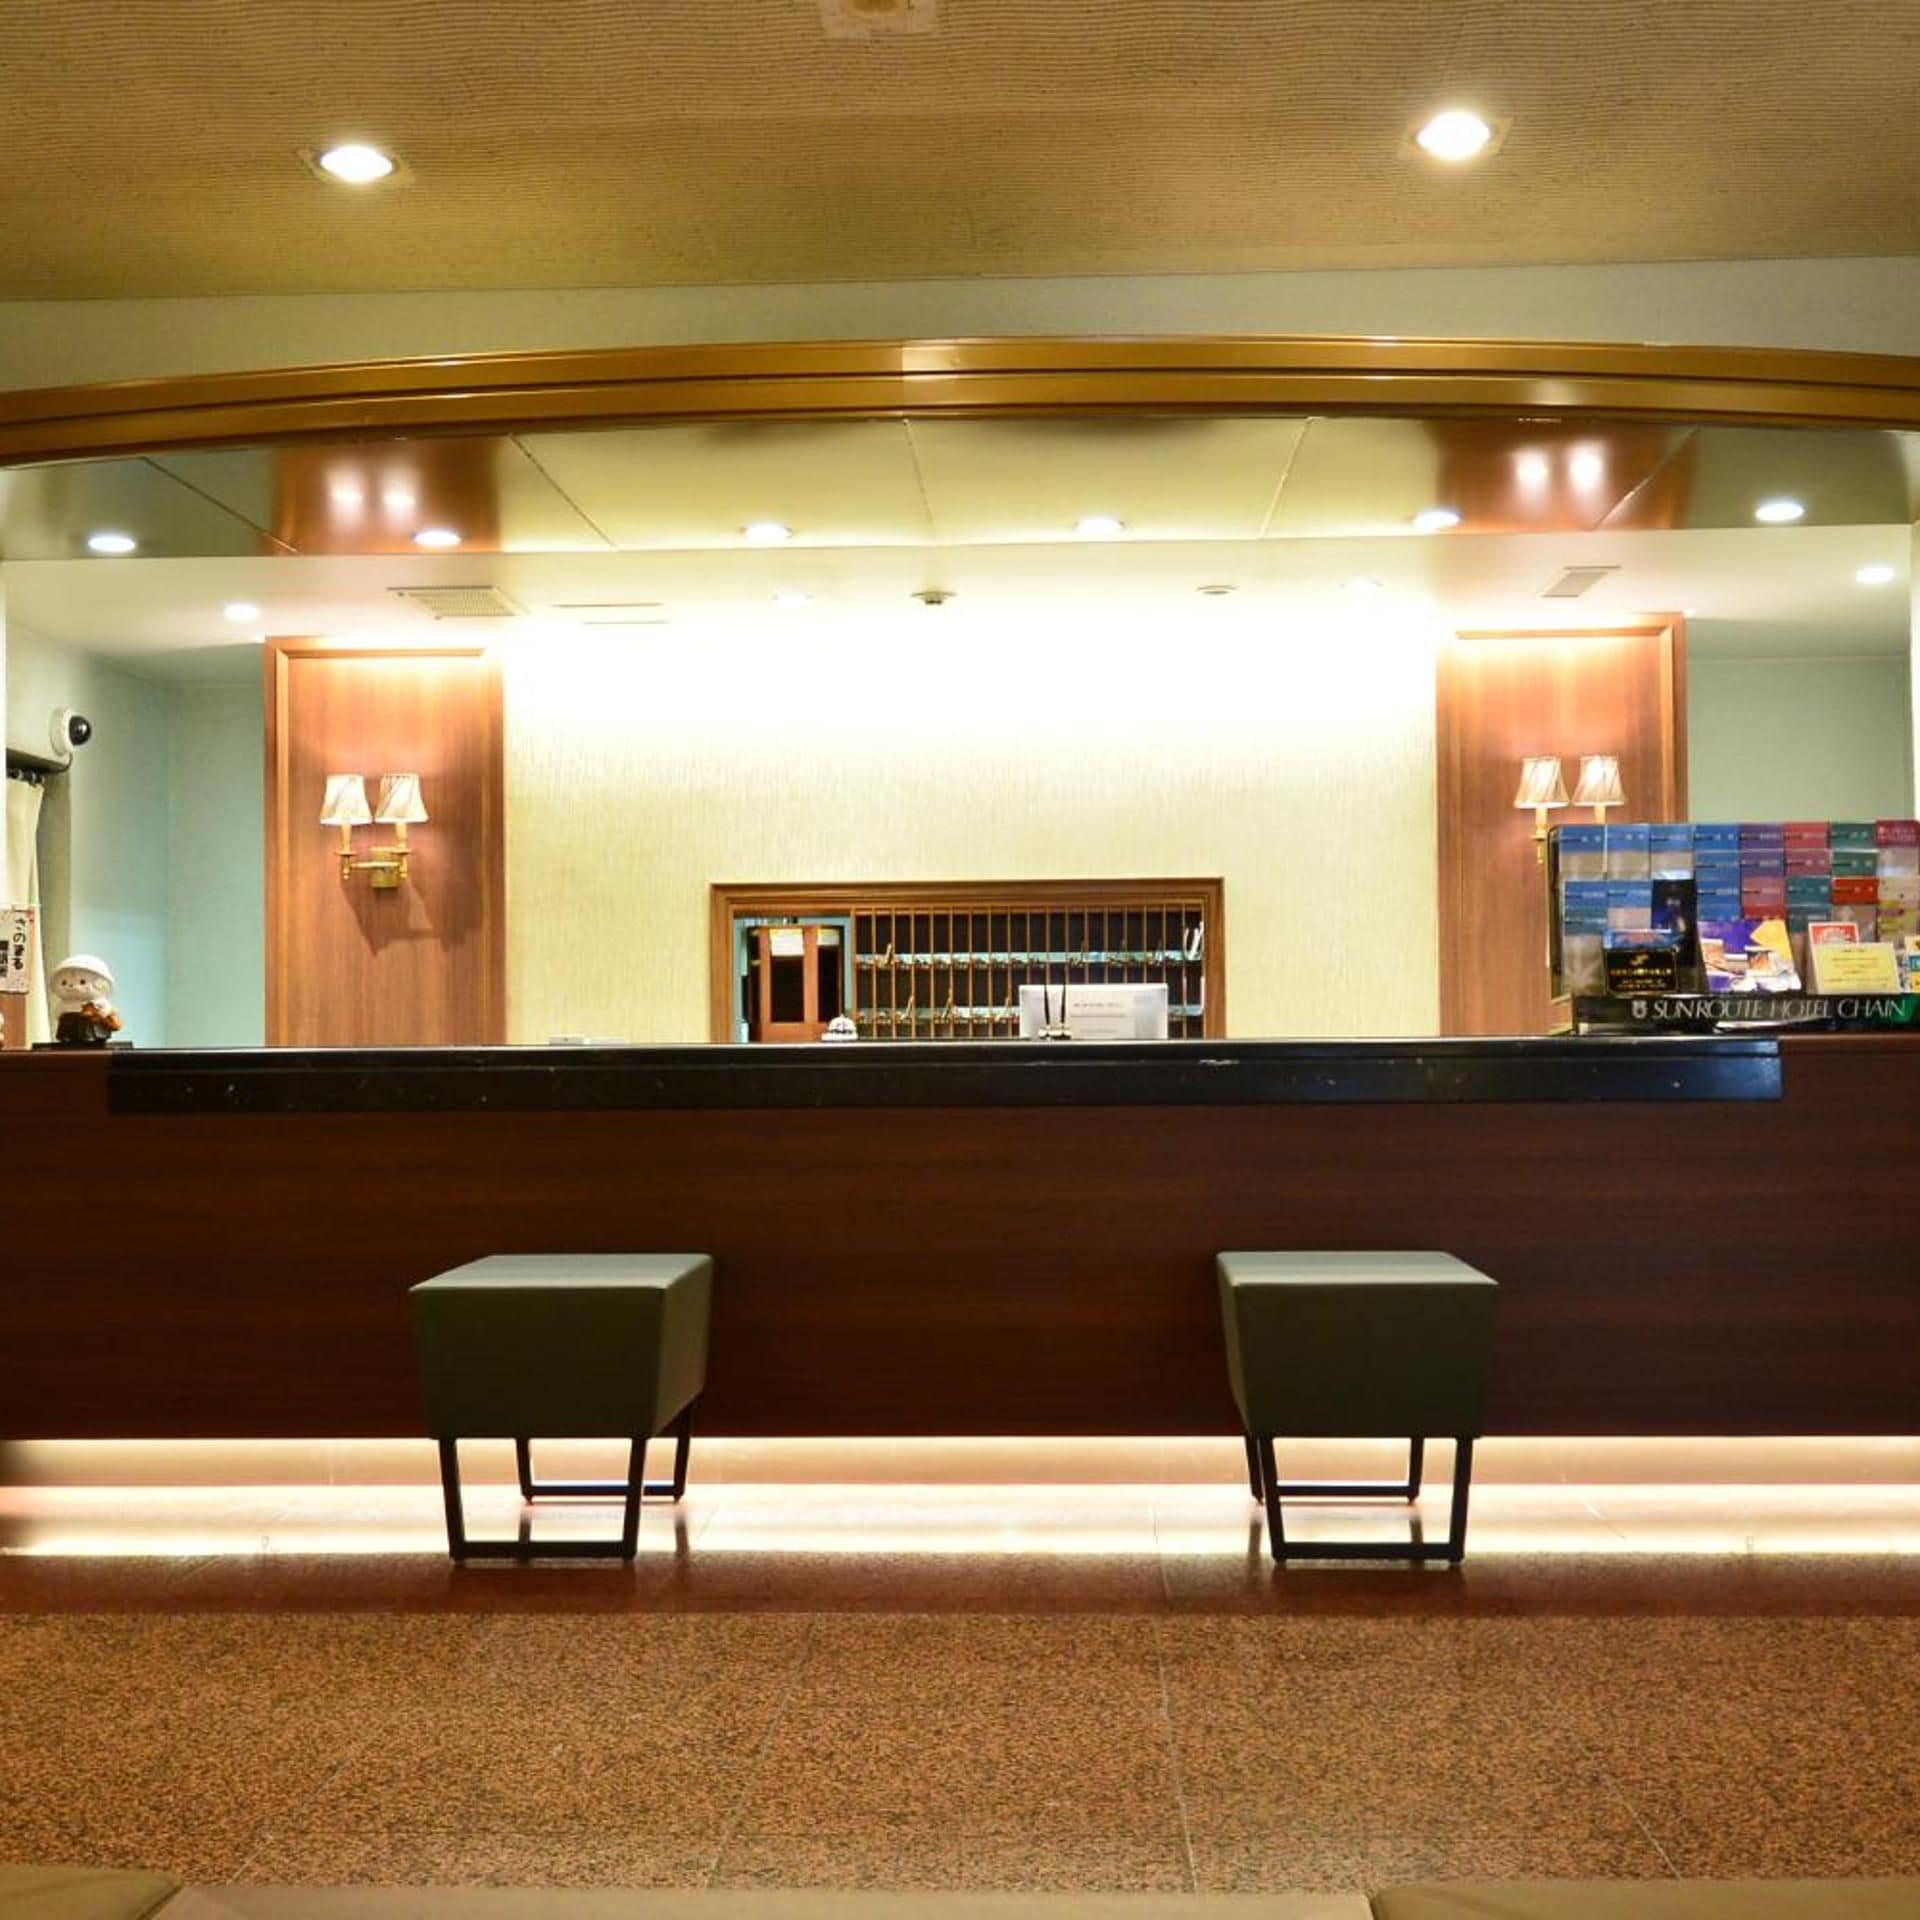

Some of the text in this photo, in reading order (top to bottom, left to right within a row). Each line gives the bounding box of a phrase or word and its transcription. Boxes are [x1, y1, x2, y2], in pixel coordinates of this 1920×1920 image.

[1652, 998, 1906, 1019] SUNROUTE HOTEL CHAIN
